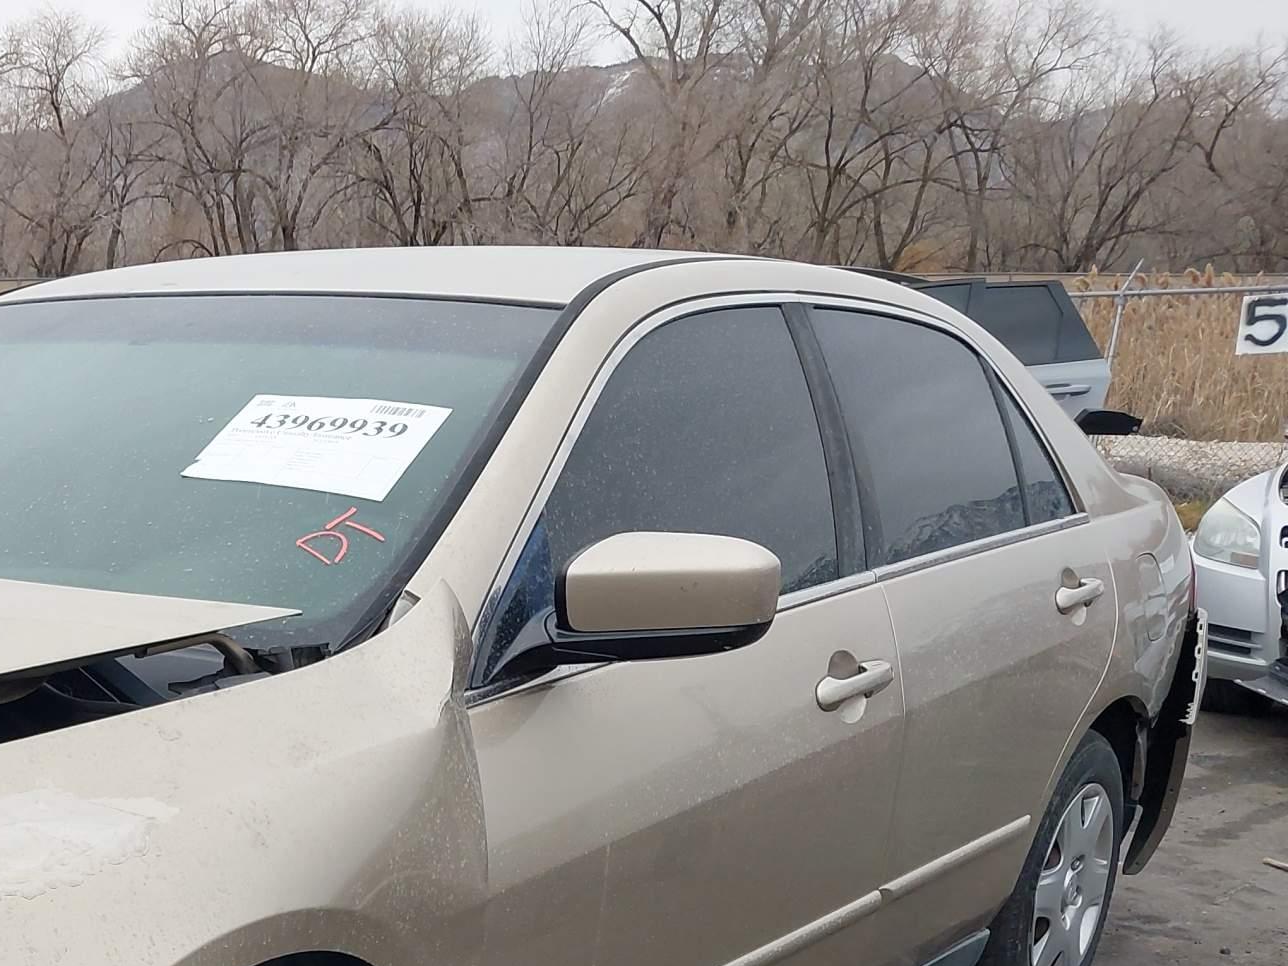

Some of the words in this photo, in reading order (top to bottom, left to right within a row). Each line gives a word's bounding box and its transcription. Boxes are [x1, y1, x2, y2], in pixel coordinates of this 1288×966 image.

[1244, 298, 1288, 347] 5
[250, 413, 409, 438] 43969939
[296, 507, 385, 565] DT
